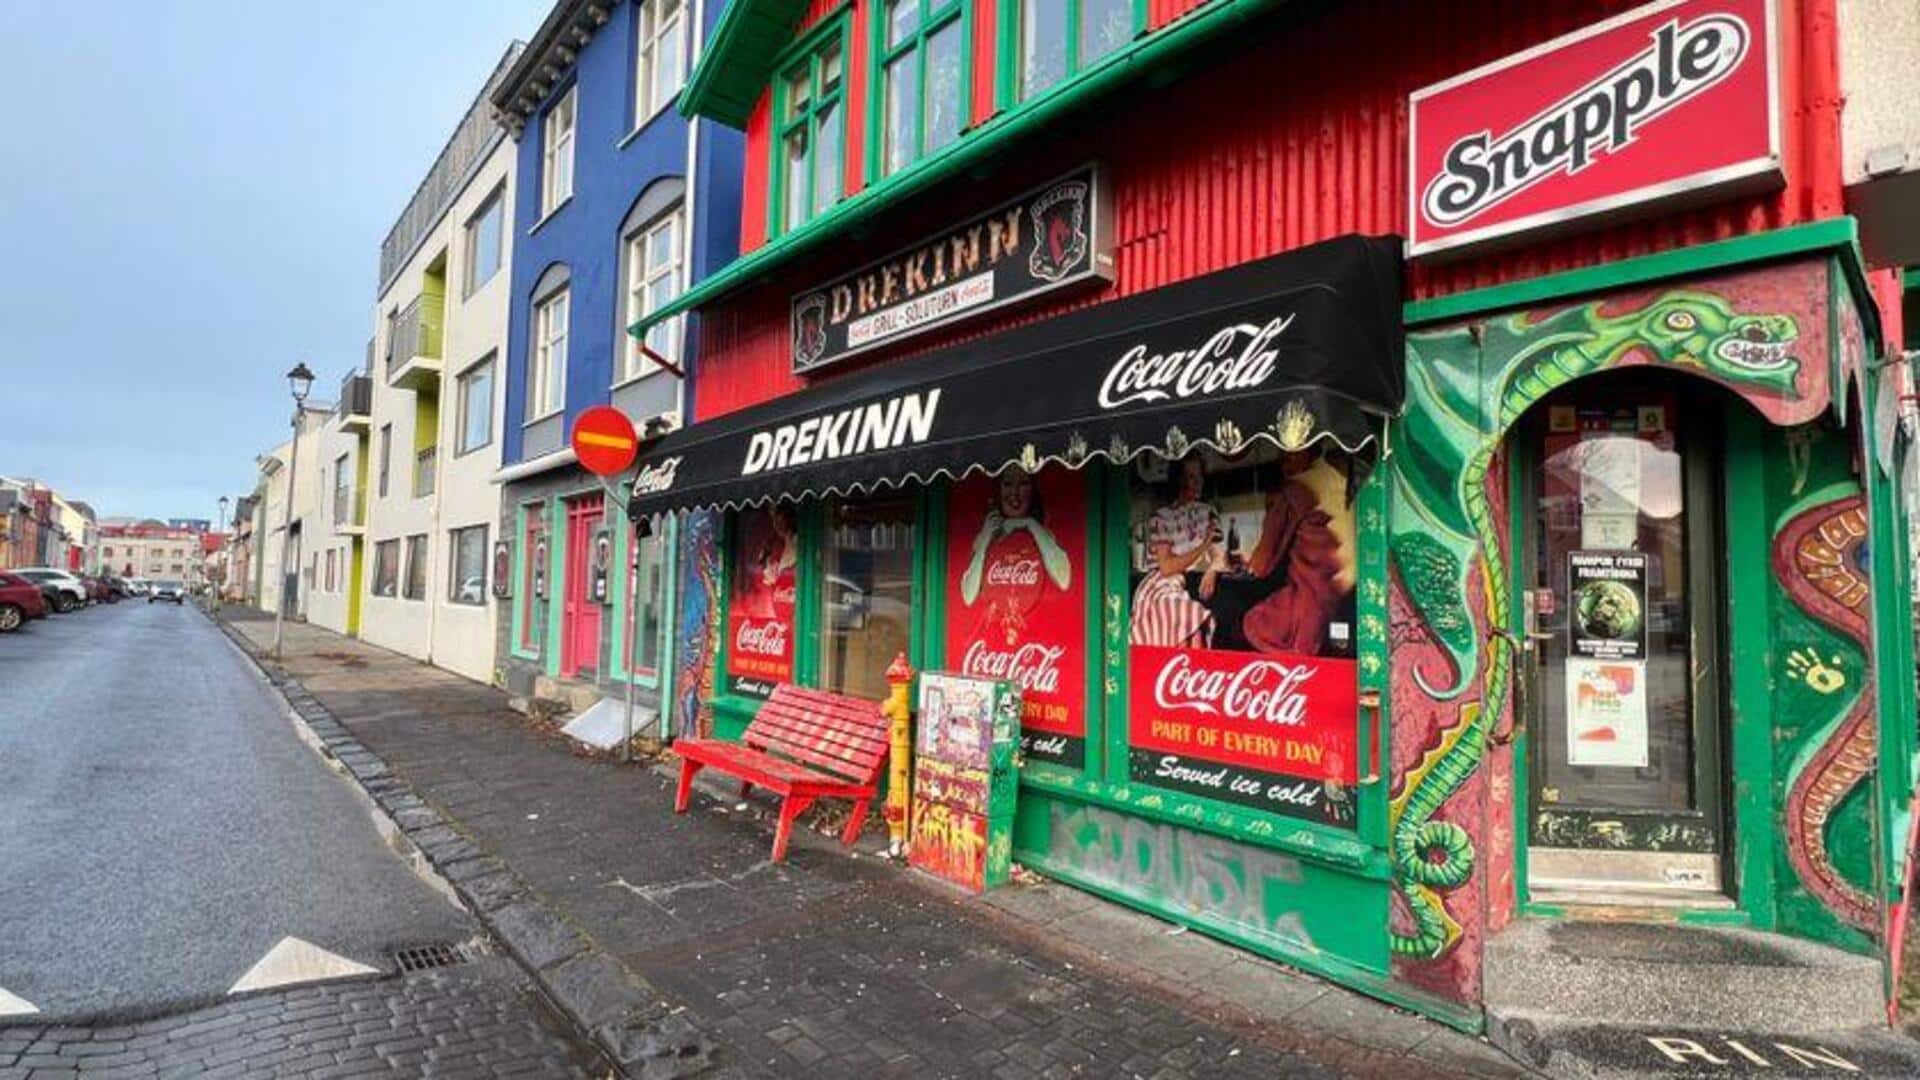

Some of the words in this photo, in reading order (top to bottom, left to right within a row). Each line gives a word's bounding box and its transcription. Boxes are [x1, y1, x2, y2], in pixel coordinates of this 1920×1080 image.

[1436, 22, 1722, 213] Snapple
[830, 206, 1023, 325] DREKINN
[1098, 312, 1296, 408] Coca-Cola
[741, 388, 942, 477] DREKINN
[988, 560, 1040, 585] Coca-Cola
[736, 619, 788, 656] Coca-Cola
[963, 640, 1066, 694] Coca-Cola
[1155, 654, 1318, 725] Coca-Cola
[1045, 704, 1068, 723] DAY
[1034, 737, 1067, 755] cold
[1152, 720, 1193, 743] PART
[1197, 726, 1220, 747] OF
[1224, 731, 1281, 757] EVERY
[1285, 741, 1325, 764] DAY
[1155, 756, 1228, 787] Served
[1230, 775, 1262, 796] ice
[1267, 785, 1321, 807] cold
